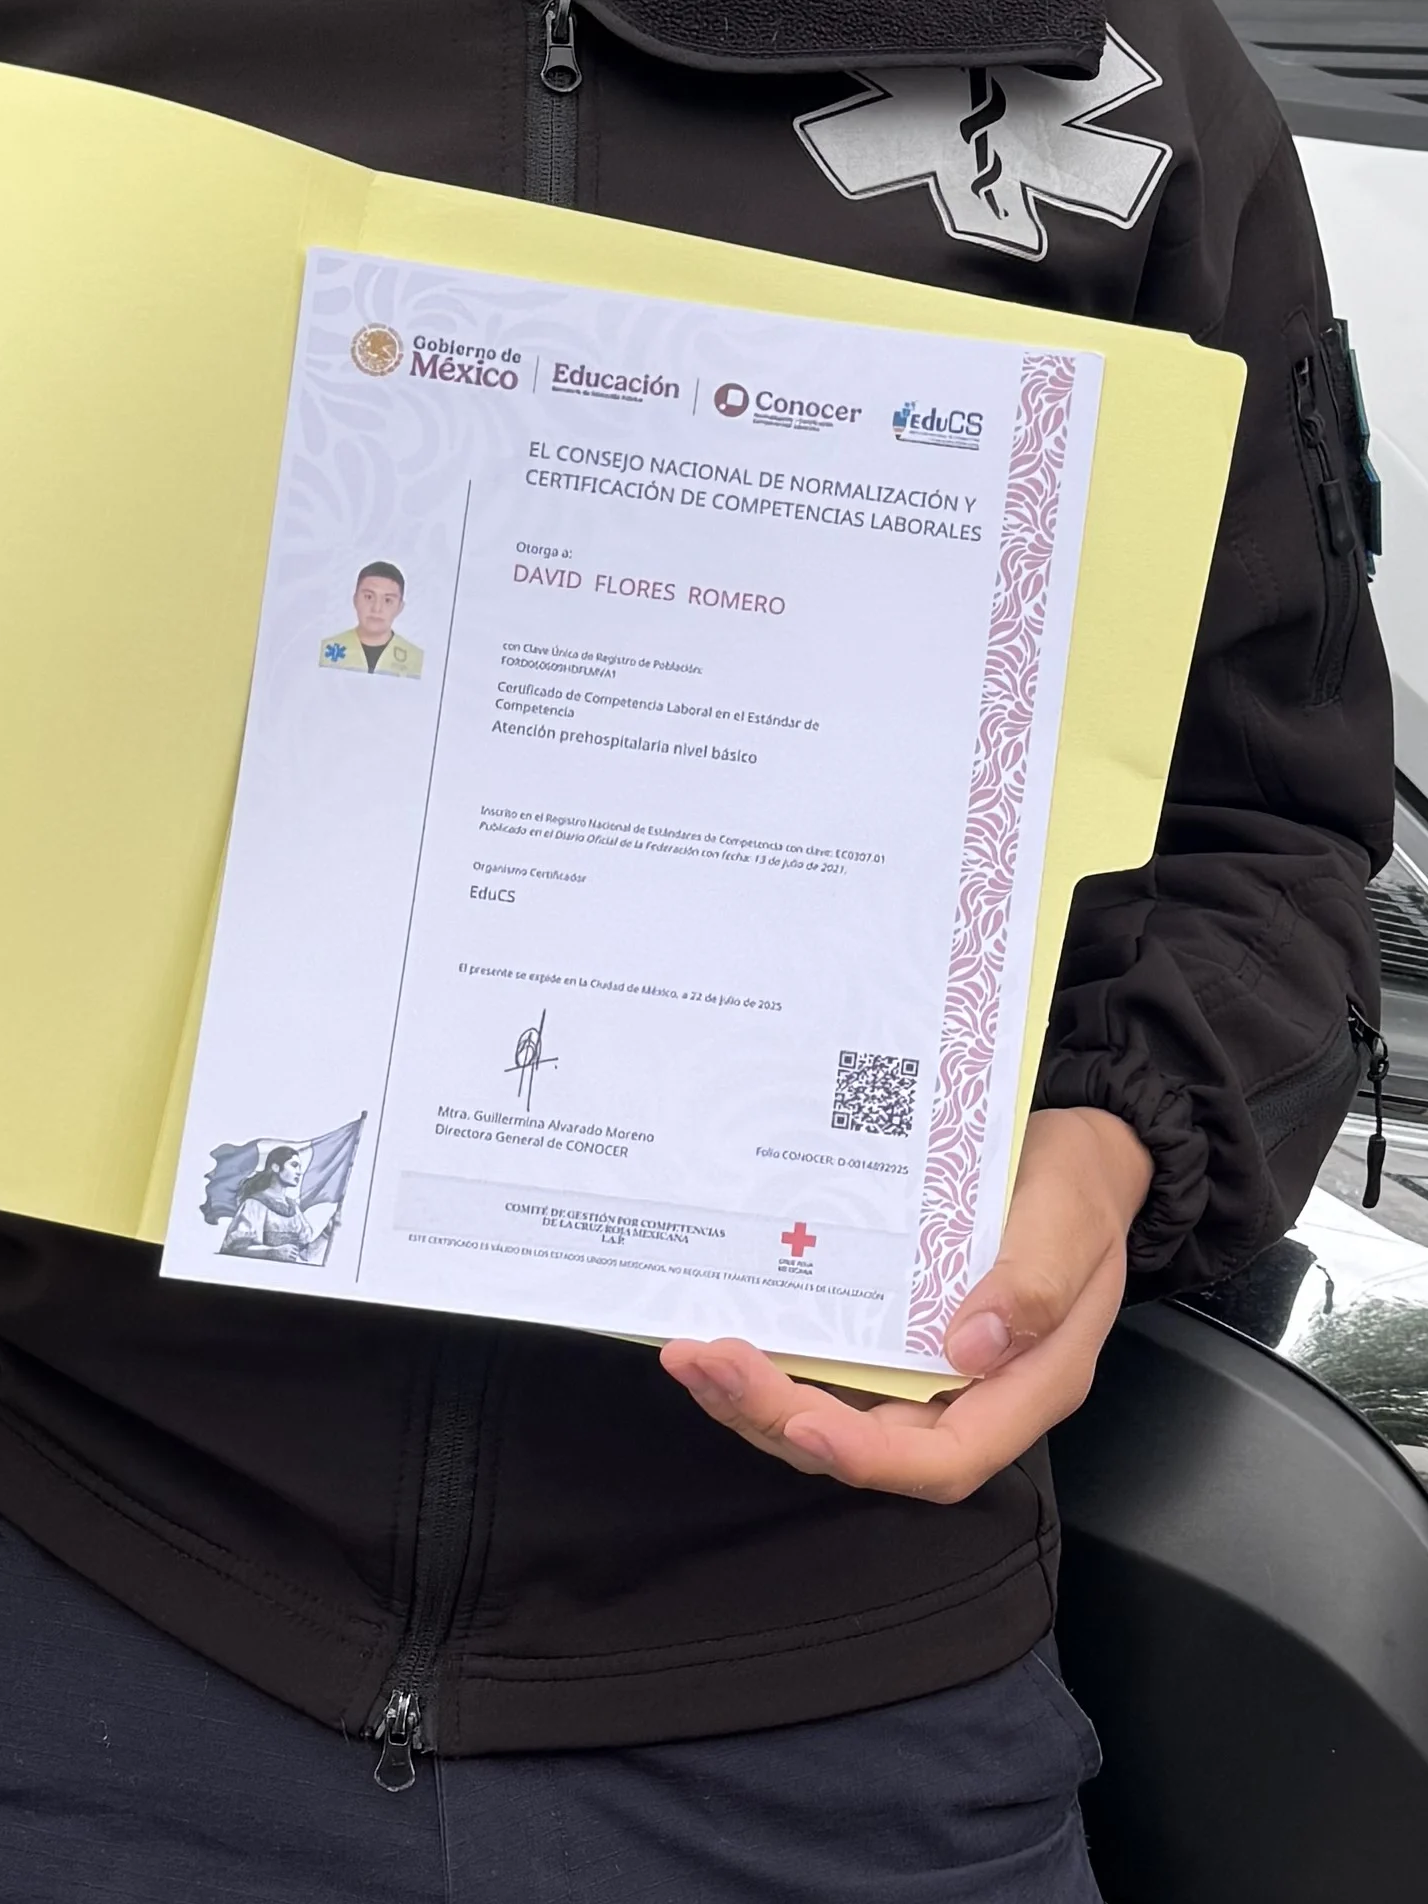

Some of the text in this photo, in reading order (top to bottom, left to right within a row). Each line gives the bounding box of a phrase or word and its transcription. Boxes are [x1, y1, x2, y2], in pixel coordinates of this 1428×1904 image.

[412, 334, 521, 364] Gobierno de
[408, 349, 519, 390] México
[551, 362, 680, 399] Educación
[754, 390, 862, 423] Conocer
[910, 406, 984, 437] EduCS
[528, 440, 976, 513] EL CONSEJO NACIONAL DE NORMALIZACIÓN Y
[525, 468, 982, 542] CERTIFICACIÓN DE COMPETENCIAS LABORALES
[515, 541, 572, 559] Otorga a:
[513, 563, 785, 615] DAVID FLORES ROMERO
[502, 642, 521, 652] con
[580, 650, 594, 661] de
[595, 652, 637, 666] Registro
[637, 657, 651, 668] de
[494, 697, 575, 718] Competencia
[497, 680, 819, 731] Certificado de Competencia Laboral en el Estándar de
[491, 719, 757, 764] Atención prehospitalaria nivel básico
[478, 820, 527, 835] Publicado
[528, 828, 542, 837] en
[619, 838, 633, 848] de
[767, 855, 781, 866] de
[519, 811, 532, 820] en
[533, 812, 544, 822] el
[544, 812, 587, 828] Registro
[587, 818, 631, 833] Nacional
[632, 823, 646, 835] de
[647, 825, 702, 841] Estándares
[703, 832, 717, 843] de
[718, 834, 783, 851] Competencia
[785, 844, 803, 853] con
[472, 860, 528, 877] Organismo
[469, 884, 515, 903] EduCS
[468, 965, 513, 978] presente
[562, 977, 577, 986] en
[589, 978, 625, 992] Ciudad
[625, 983, 639, 994] de
[742, 997, 756, 1008] de
[434, 1122, 628, 1158] Directora General de CONOCER
[437, 1105, 654, 1143] Mtra. Guillermina Alvarado Moreno
[541, 1215, 689, 1244] DE LA CRUZ ROJA MEXICANA
[550, 1207, 566, 1218] DE
